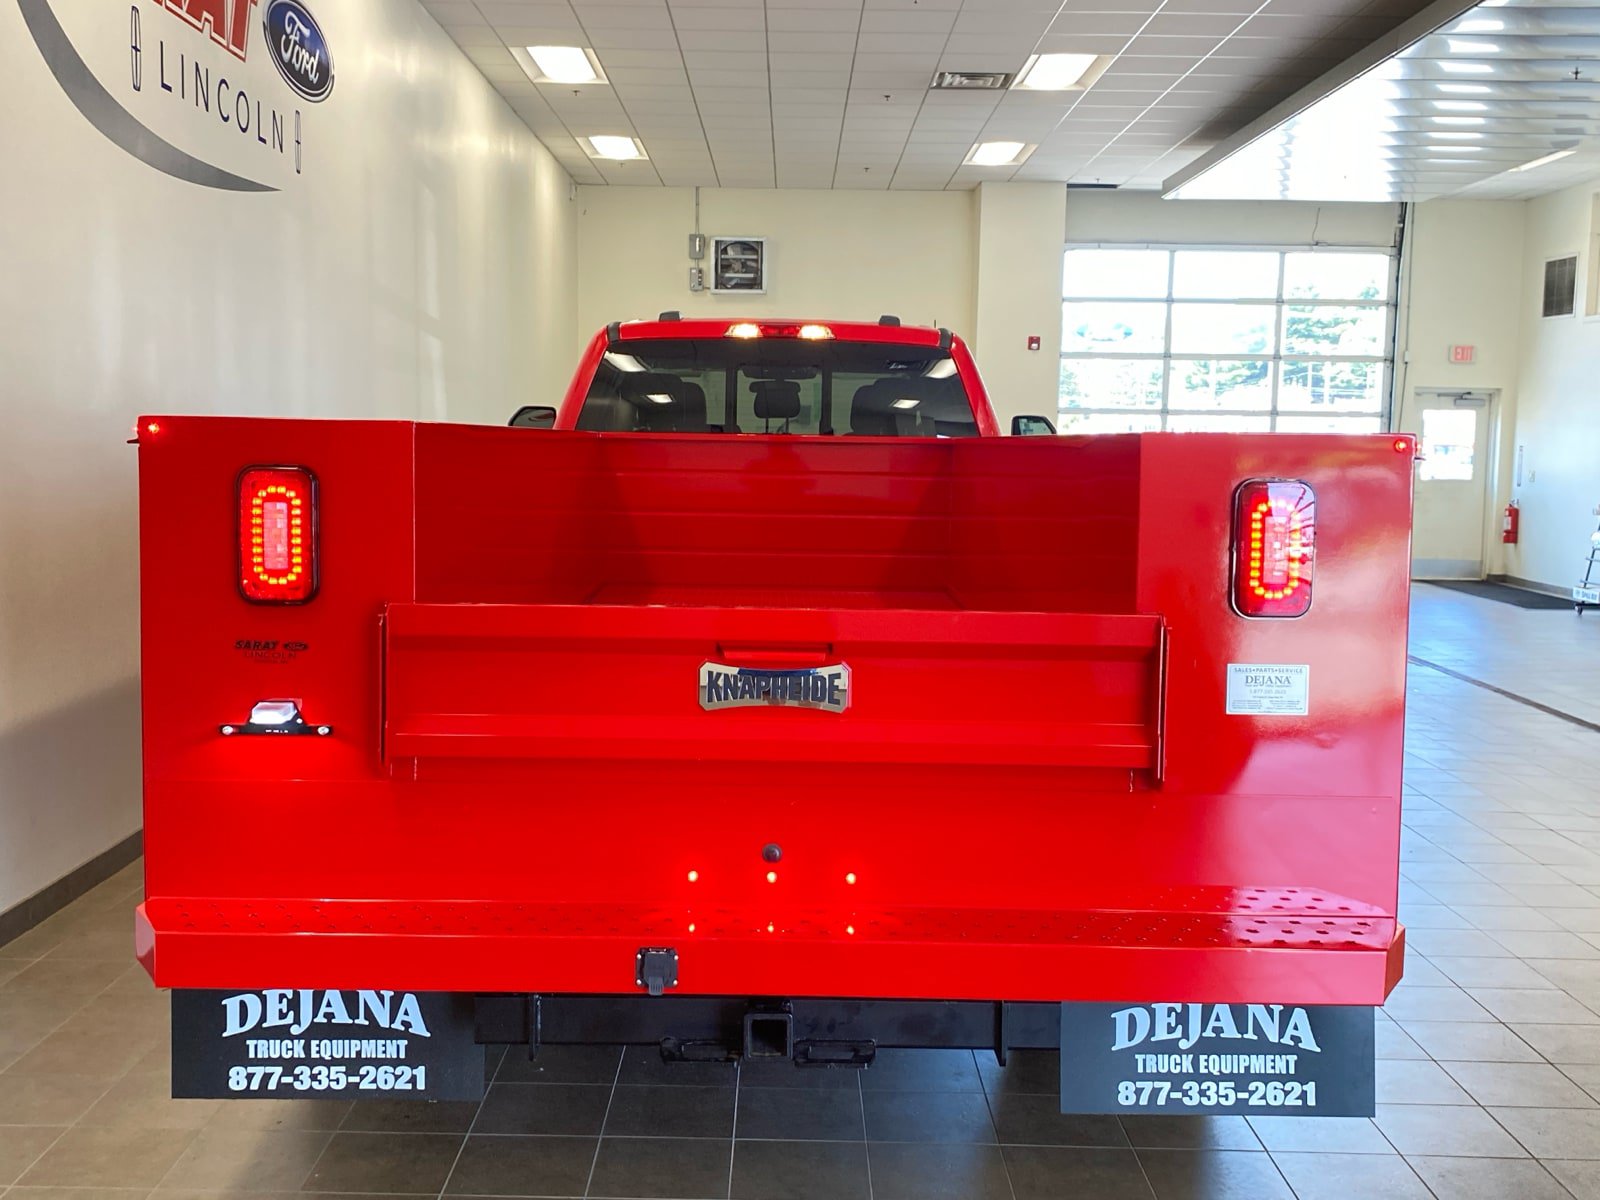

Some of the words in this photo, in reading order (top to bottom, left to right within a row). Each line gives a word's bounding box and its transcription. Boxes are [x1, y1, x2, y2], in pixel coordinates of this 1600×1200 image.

[281, 11, 320, 84] Ford
[160, 40, 284, 154] LINCOLN
[707, 669, 841, 706] KNAPHEIDE
[1245, 675, 1292, 687] DEJANA
[221, 989, 432, 1038] DEJANA
[1110, 1002, 1322, 1052] DEJANA
[246, 1039, 306, 1059] TRUCK
[310, 1039, 408, 1060] EQUIPMENT
[1134, 1054, 1194, 1074] TRUCK
[1199, 1054, 1298, 1076] EQUIPMENT
[228, 1065, 426, 1091] 877-335-2621
[1117, 1081, 1317, 1107] 877-335-2621
